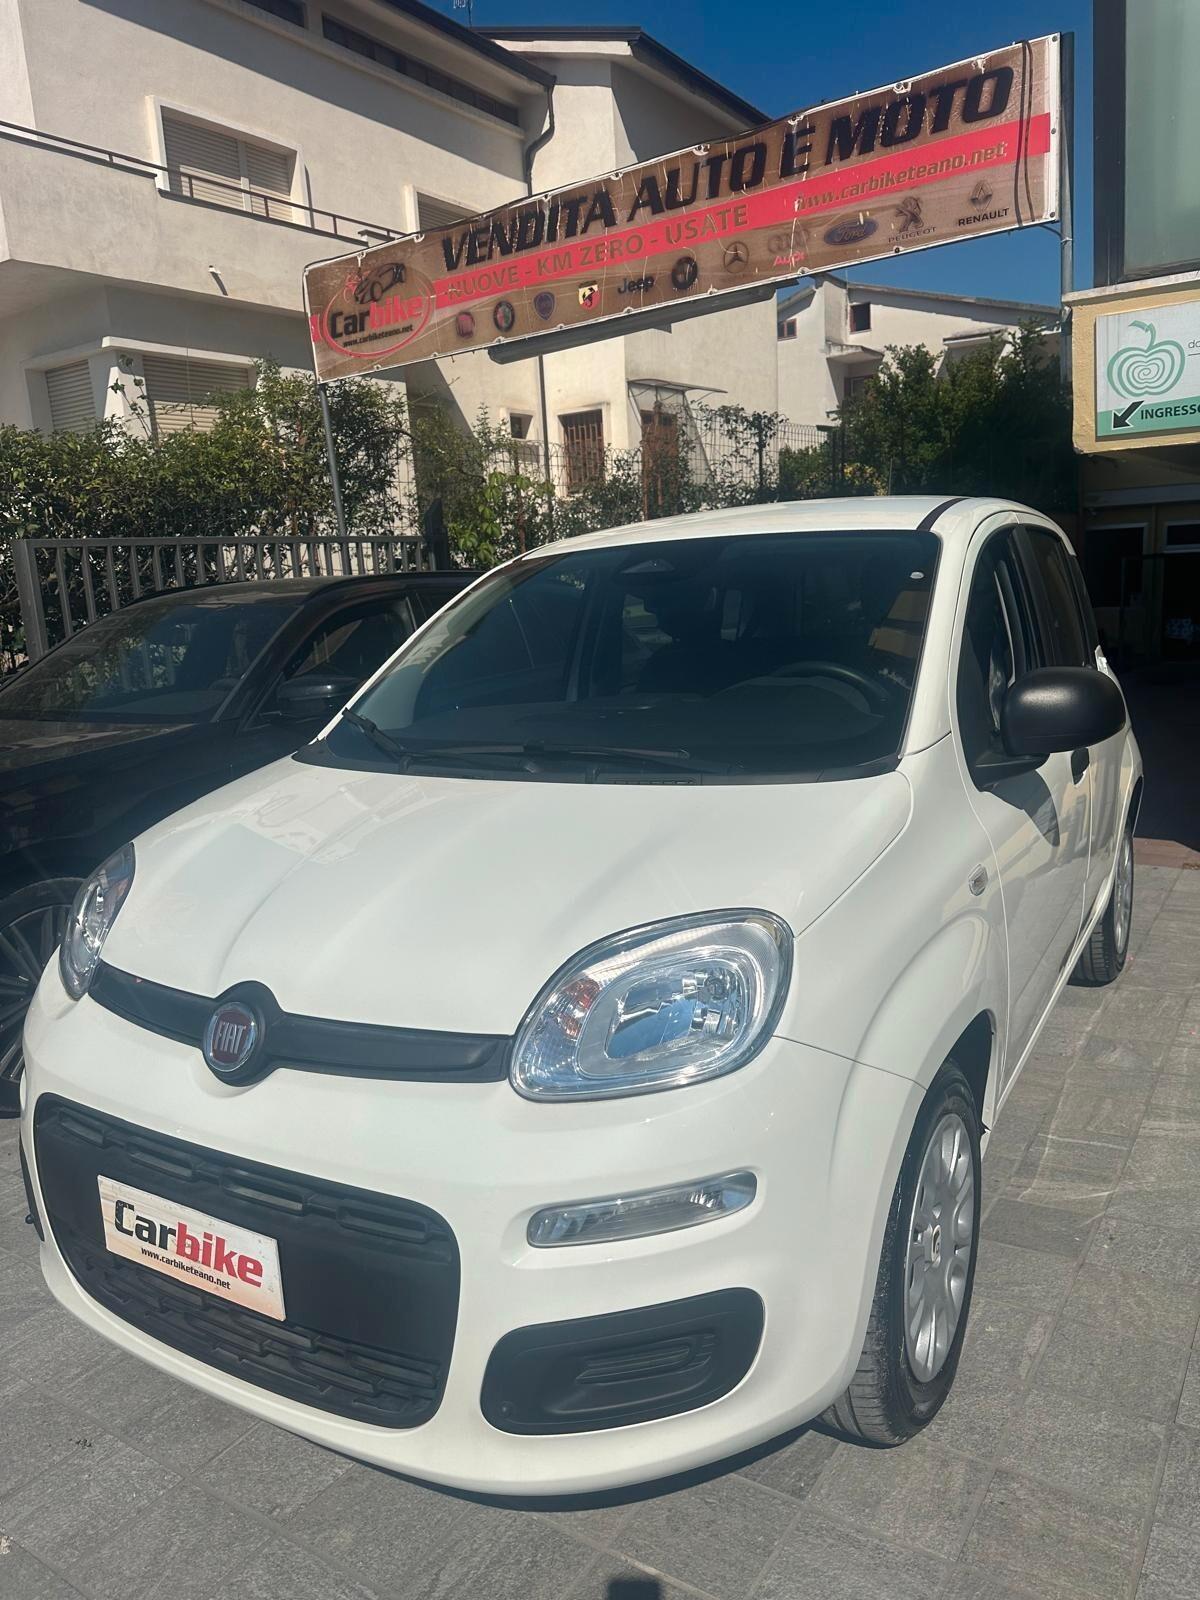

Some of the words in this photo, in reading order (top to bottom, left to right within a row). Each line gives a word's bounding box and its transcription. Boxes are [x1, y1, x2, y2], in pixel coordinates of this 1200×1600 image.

[441, 186, 617, 272] VENDITA
[627, 142, 768, 222] AUTO
[778, 122, 816, 180] E
[823, 65, 1015, 166] MOTO
[888, 225, 937, 244] PEUGEOT
[957, 207, 1010, 227] RENAULT
[446, 265, 520, 299] NUOVE
[536, 251, 573, 277] KM
[579, 234, 644, 267] ZERO
[665, 203, 749, 245] USATE
[617, 275, 655, 295] Jeep
[330, 295, 423, 340] Carbike
[342, 323, 414, 348] www.carbiketeano.net
[1140, 403, 1200, 420] INGRESS
[213, 1020, 248, 1055] FIAT
[114, 1199, 264, 1289] Carbike
[140, 1246, 232, 1290] www.carbiketeano.net
